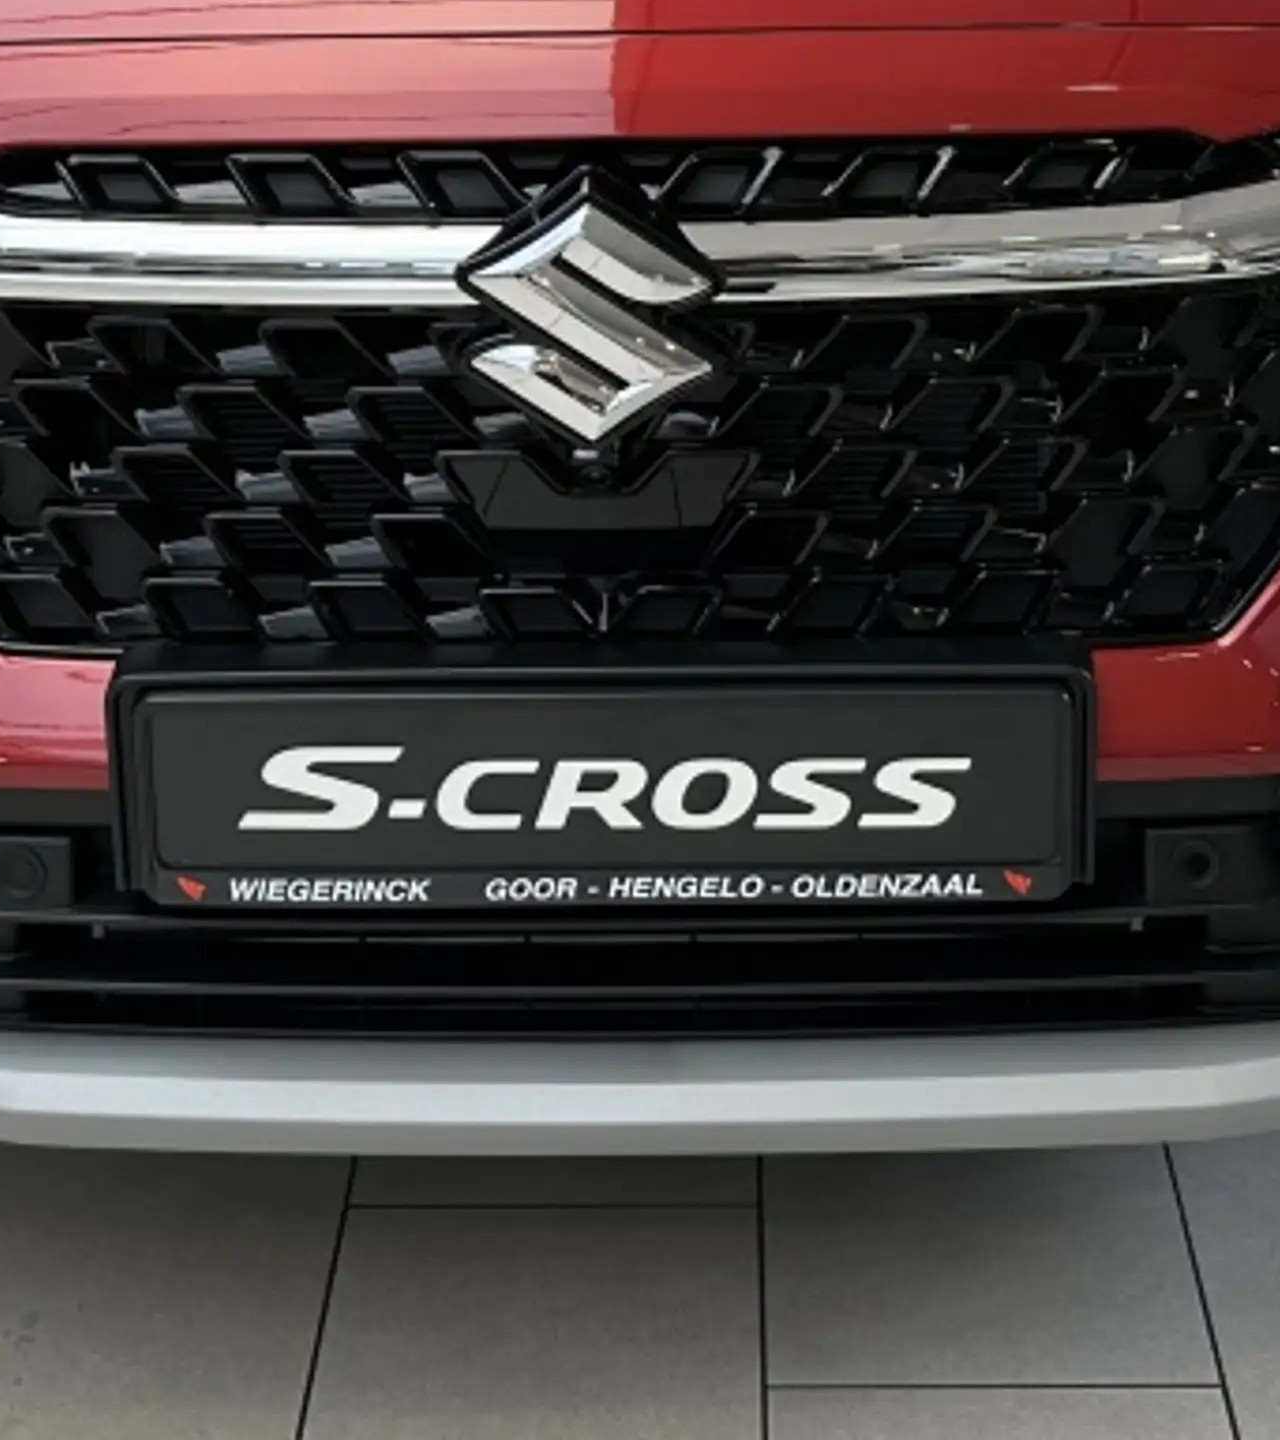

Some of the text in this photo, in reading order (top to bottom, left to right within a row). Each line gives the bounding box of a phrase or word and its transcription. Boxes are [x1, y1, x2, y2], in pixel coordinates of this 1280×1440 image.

[236, 745, 973, 831] S-CROSS
[229, 876, 432, 903] WIEGERINCK
[484, 876, 578, 902] GOOR
[608, 875, 764, 900] HENGELO
[790, 872, 984, 898] OLDENZAAL
